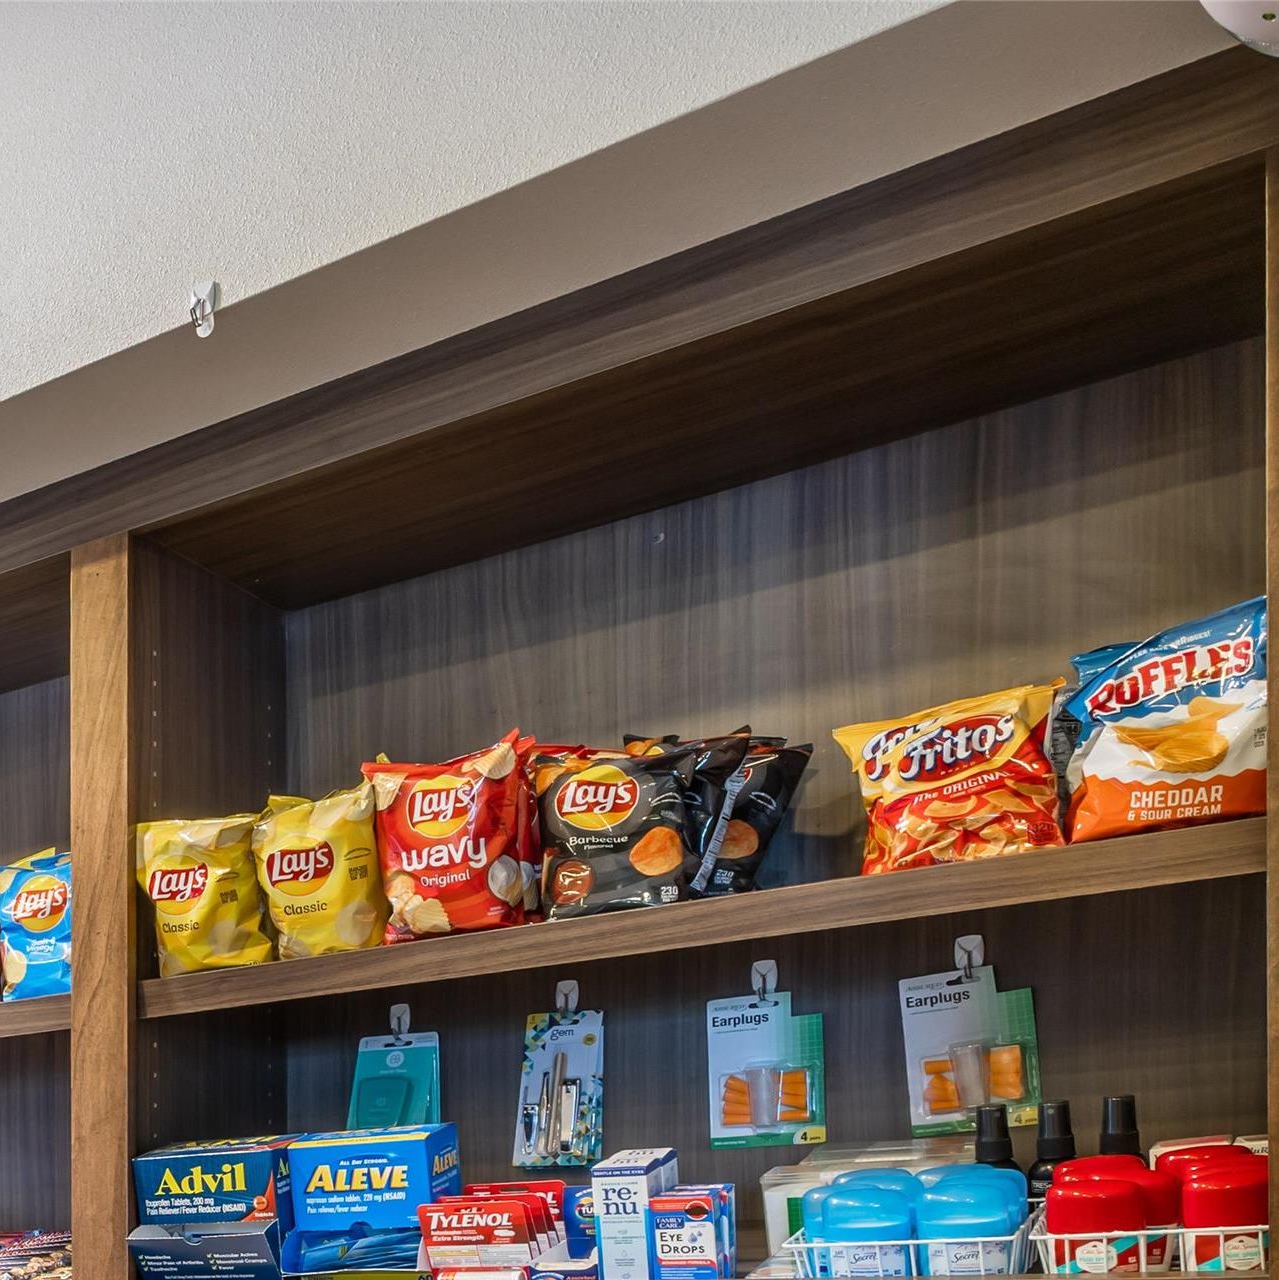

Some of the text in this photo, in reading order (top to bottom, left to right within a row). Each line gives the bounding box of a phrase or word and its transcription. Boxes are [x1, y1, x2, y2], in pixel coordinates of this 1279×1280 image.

[1088, 639, 1255, 717] RUFFLES
[898, 716, 1013, 781] Fritos
[943, 771, 1011, 797] ORIGINAL
[413, 784, 471, 823] Lay's
[562, 782, 633, 813] Lay's
[1130, 785, 1224, 808] CHEDDAR
[1128, 803, 1221, 821] & SOUR CREAM
[569, 835, 629, 845] Barbecue
[401, 837, 487, 871] wavy
[271, 846, 330, 881] Lay's
[152, 867, 207, 900] Lay's
[420, 871, 471, 887] Original
[661, 886, 678, 895] 230
[18, 887, 65, 919] Lay's
[284, 901, 327, 916] Classic
[162, 920, 199, 933] Classic
[905, 988, 971, 1010] Earplugs
[712, 1010, 769, 1030] Earplugs
[551, 1026, 575, 1040] gem
[154, 1163, 247, 1196] Advil
[306, 1165, 408, 1193] ALEVE
[145, 1199, 168, 1207] Ibuprofen
[205, 1198, 214, 1206] mg
[147, 1207, 158, 1215] Pain
[198, 1204, 221, 1213] Reducer
[223, 1202, 247, 1213] (NSAID)
[603, 1202, 639, 1215] nu
[427, 1213, 511, 1229] TYLENOL
[660, 1231, 683, 1242] EYE
[660, 1243, 705, 1254] DROPS
[850, 1251, 876, 1264] Secret
[952, 1251, 978, 1264] Secret
